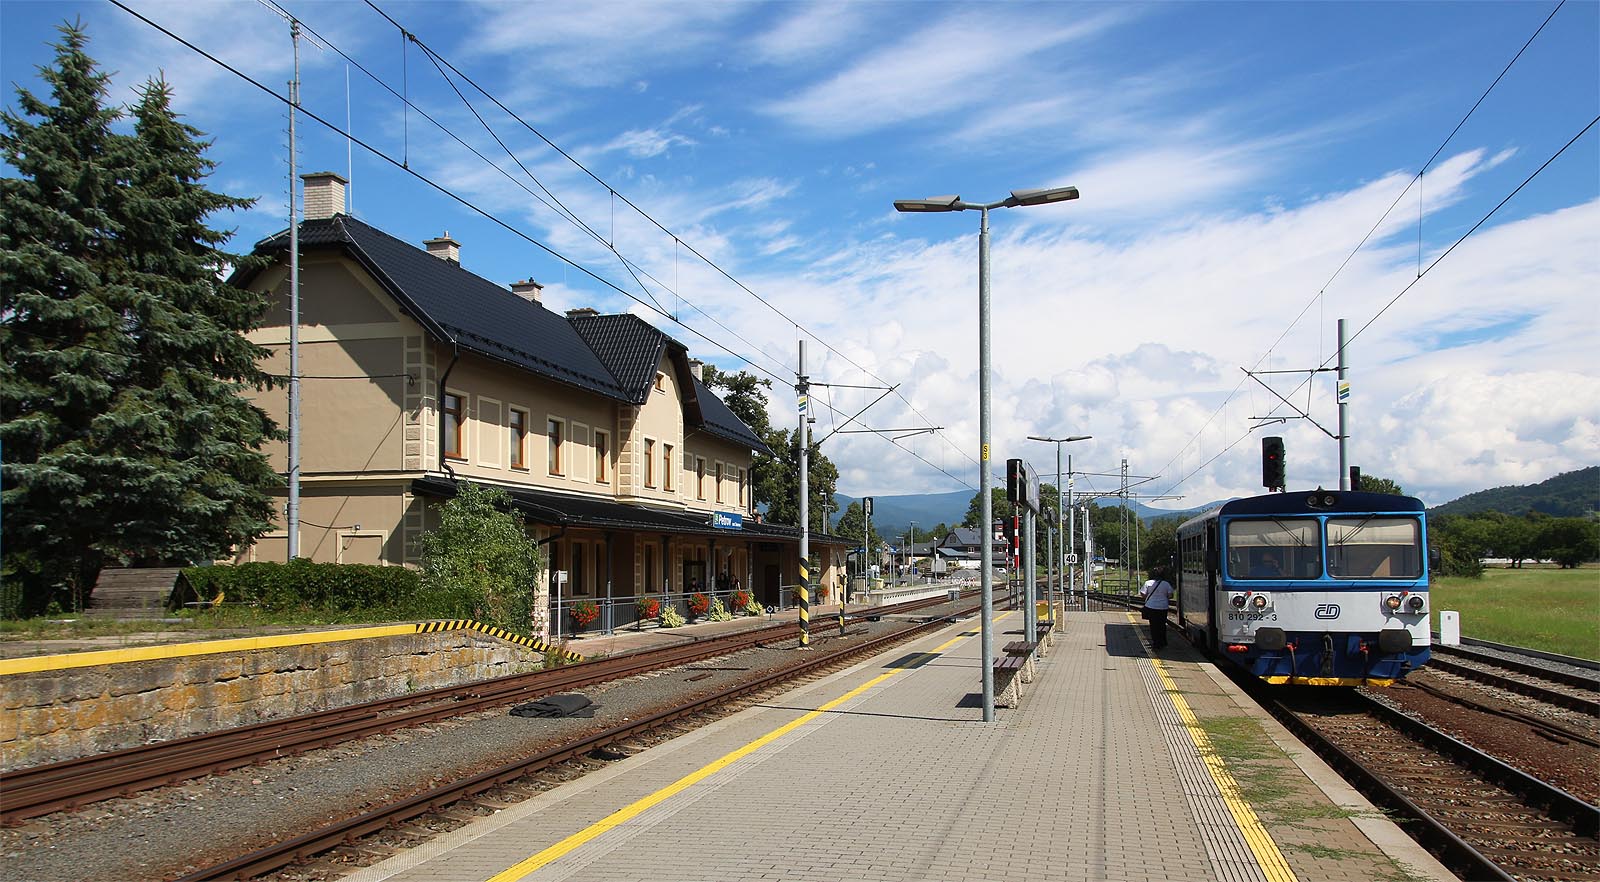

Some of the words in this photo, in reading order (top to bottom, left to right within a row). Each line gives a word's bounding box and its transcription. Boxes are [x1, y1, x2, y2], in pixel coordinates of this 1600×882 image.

[1066, 555, 1076, 563] 40
[1228, 613, 1244, 621] 810
[1247, 613, 1264, 621] 292
